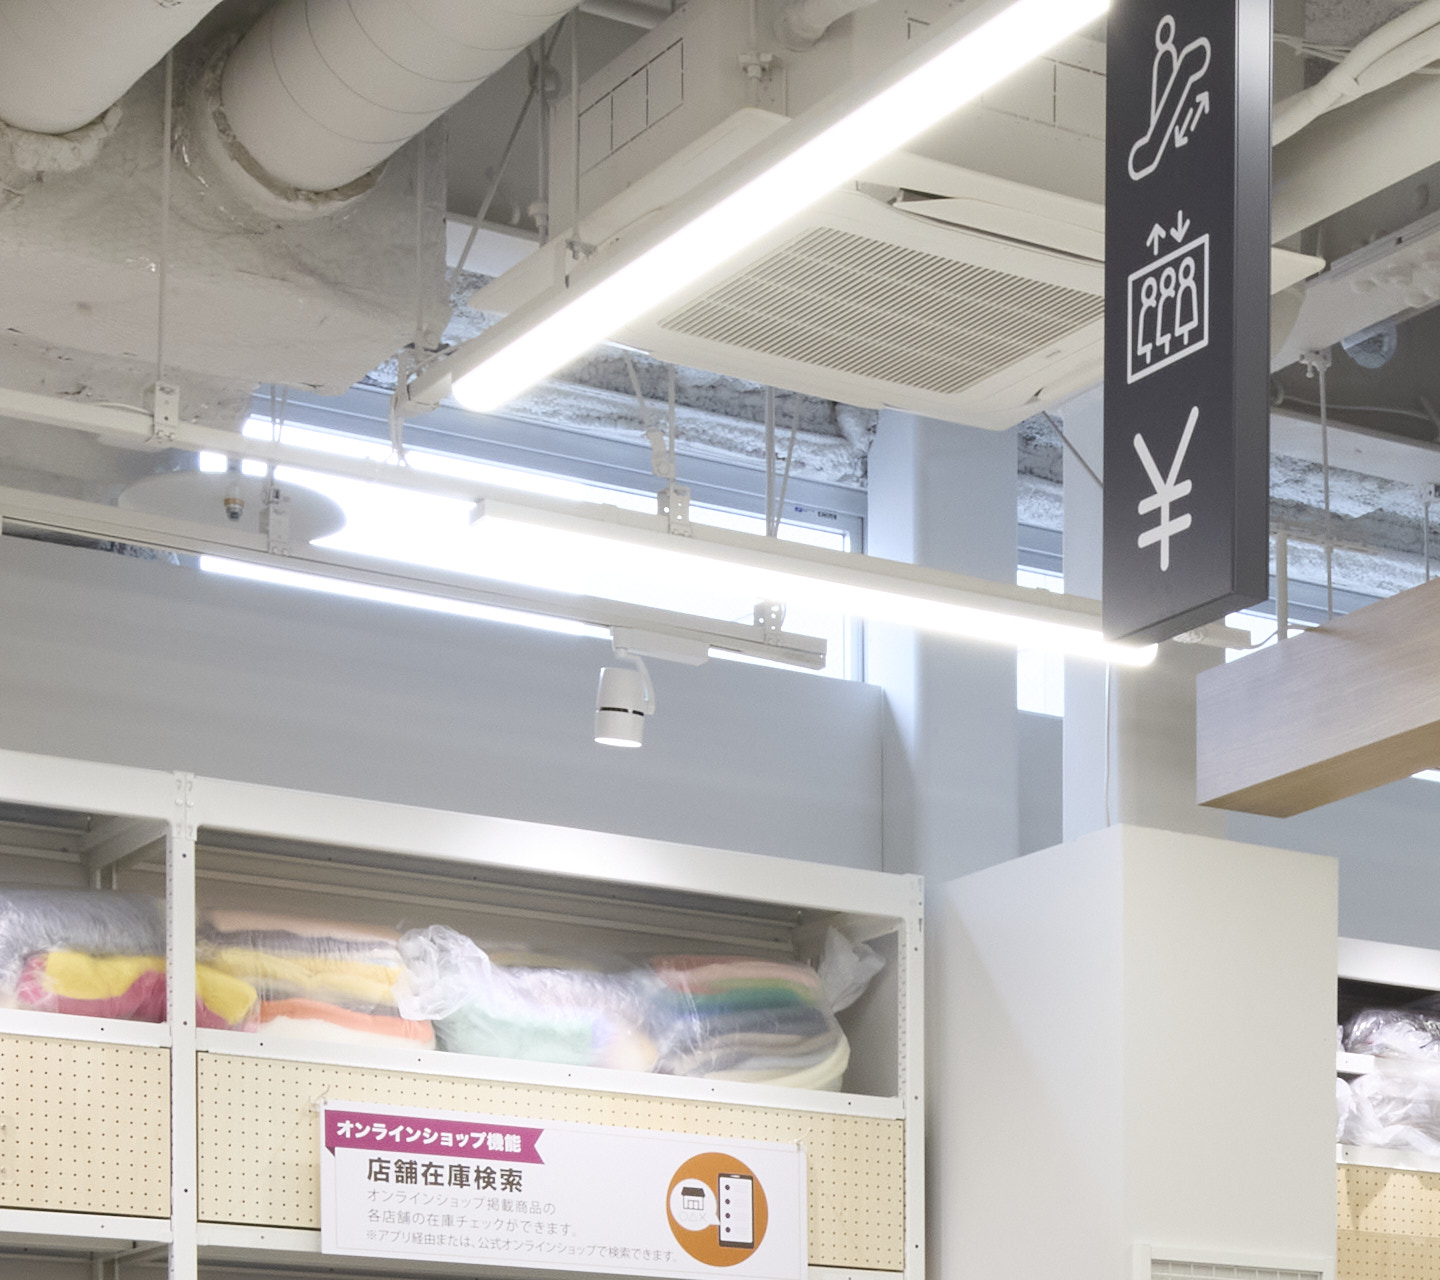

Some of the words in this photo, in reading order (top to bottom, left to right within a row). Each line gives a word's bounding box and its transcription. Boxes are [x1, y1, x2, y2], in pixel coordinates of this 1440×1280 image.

[336, 1119, 522, 1154] オンラインショップ機能
[367, 1157, 524, 1193] 店舗在庫検索
[367, 1188, 556, 1216] オンラインショップ掲載商品の
[368, 1208, 577, 1238] 各店舗の在庫チェックができます。
